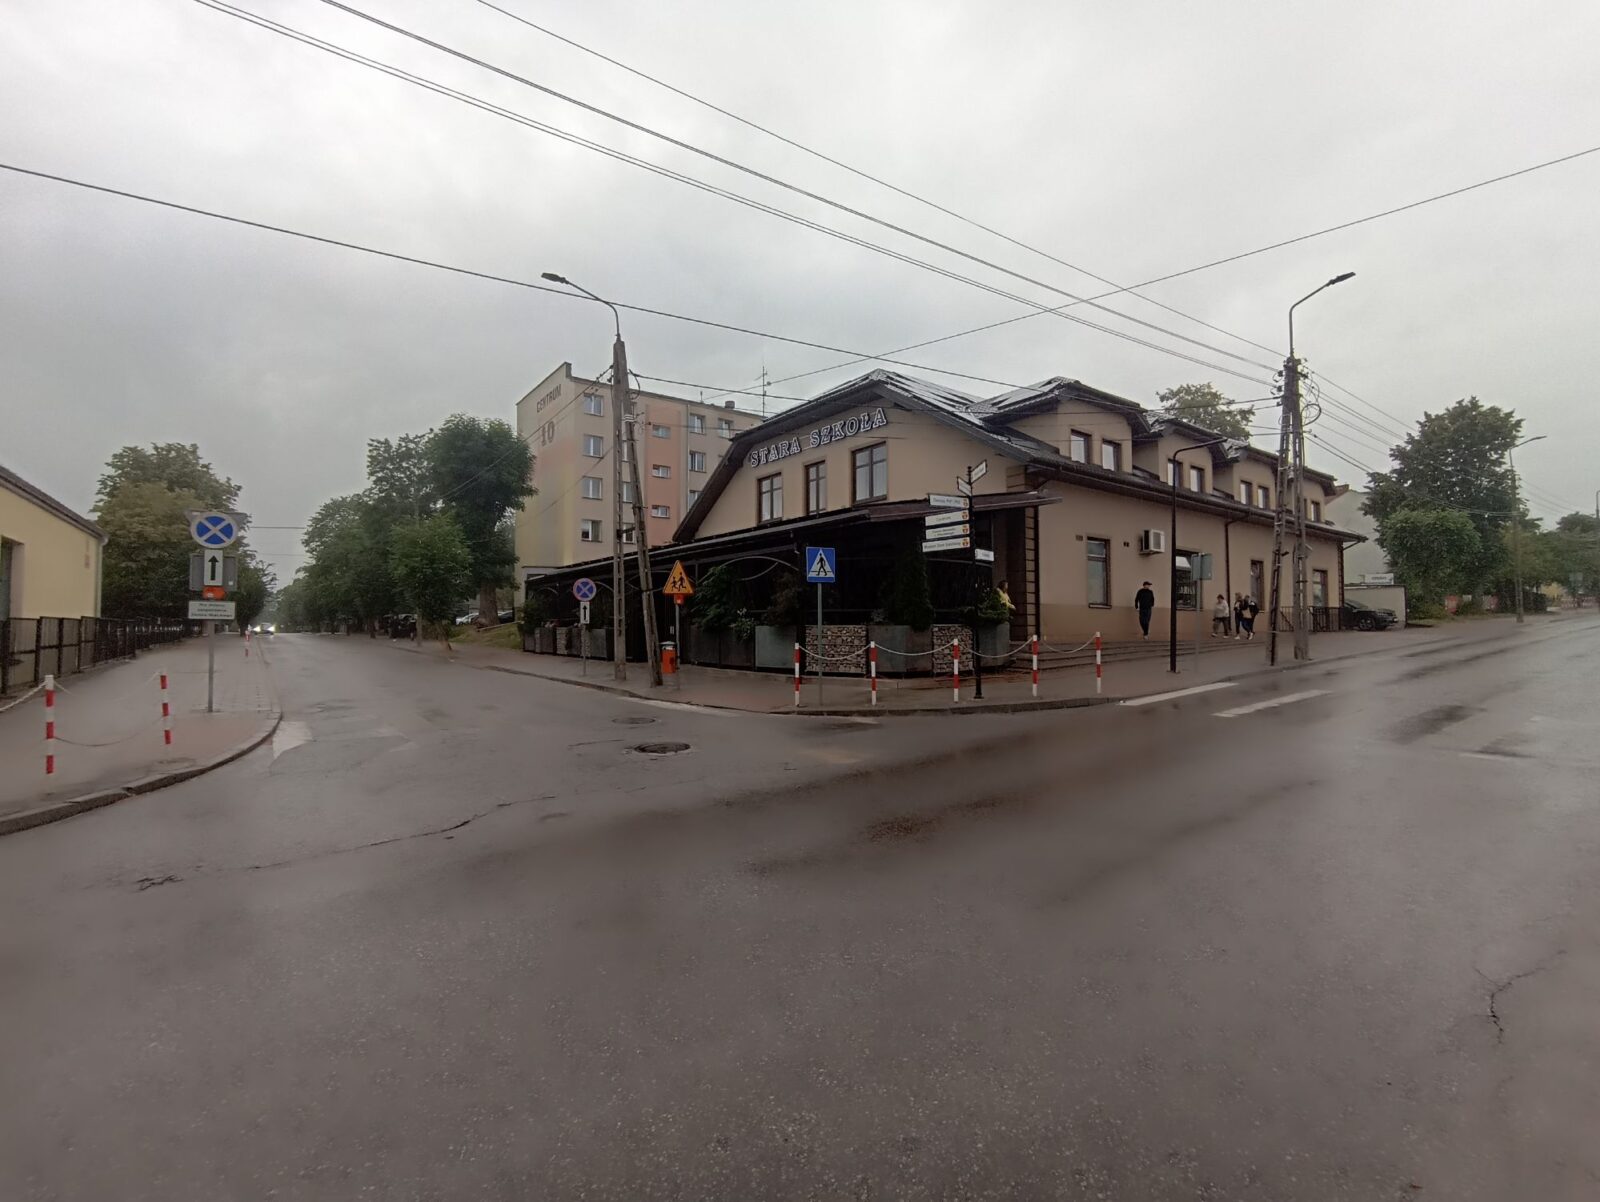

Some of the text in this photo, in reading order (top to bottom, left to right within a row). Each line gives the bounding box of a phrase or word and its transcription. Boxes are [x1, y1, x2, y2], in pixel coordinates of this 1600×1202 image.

[536, 384, 562, 413] CENTRUM
[541, 421, 555, 446] 10
[750, 407, 888, 468] STARA SZKOŁA
